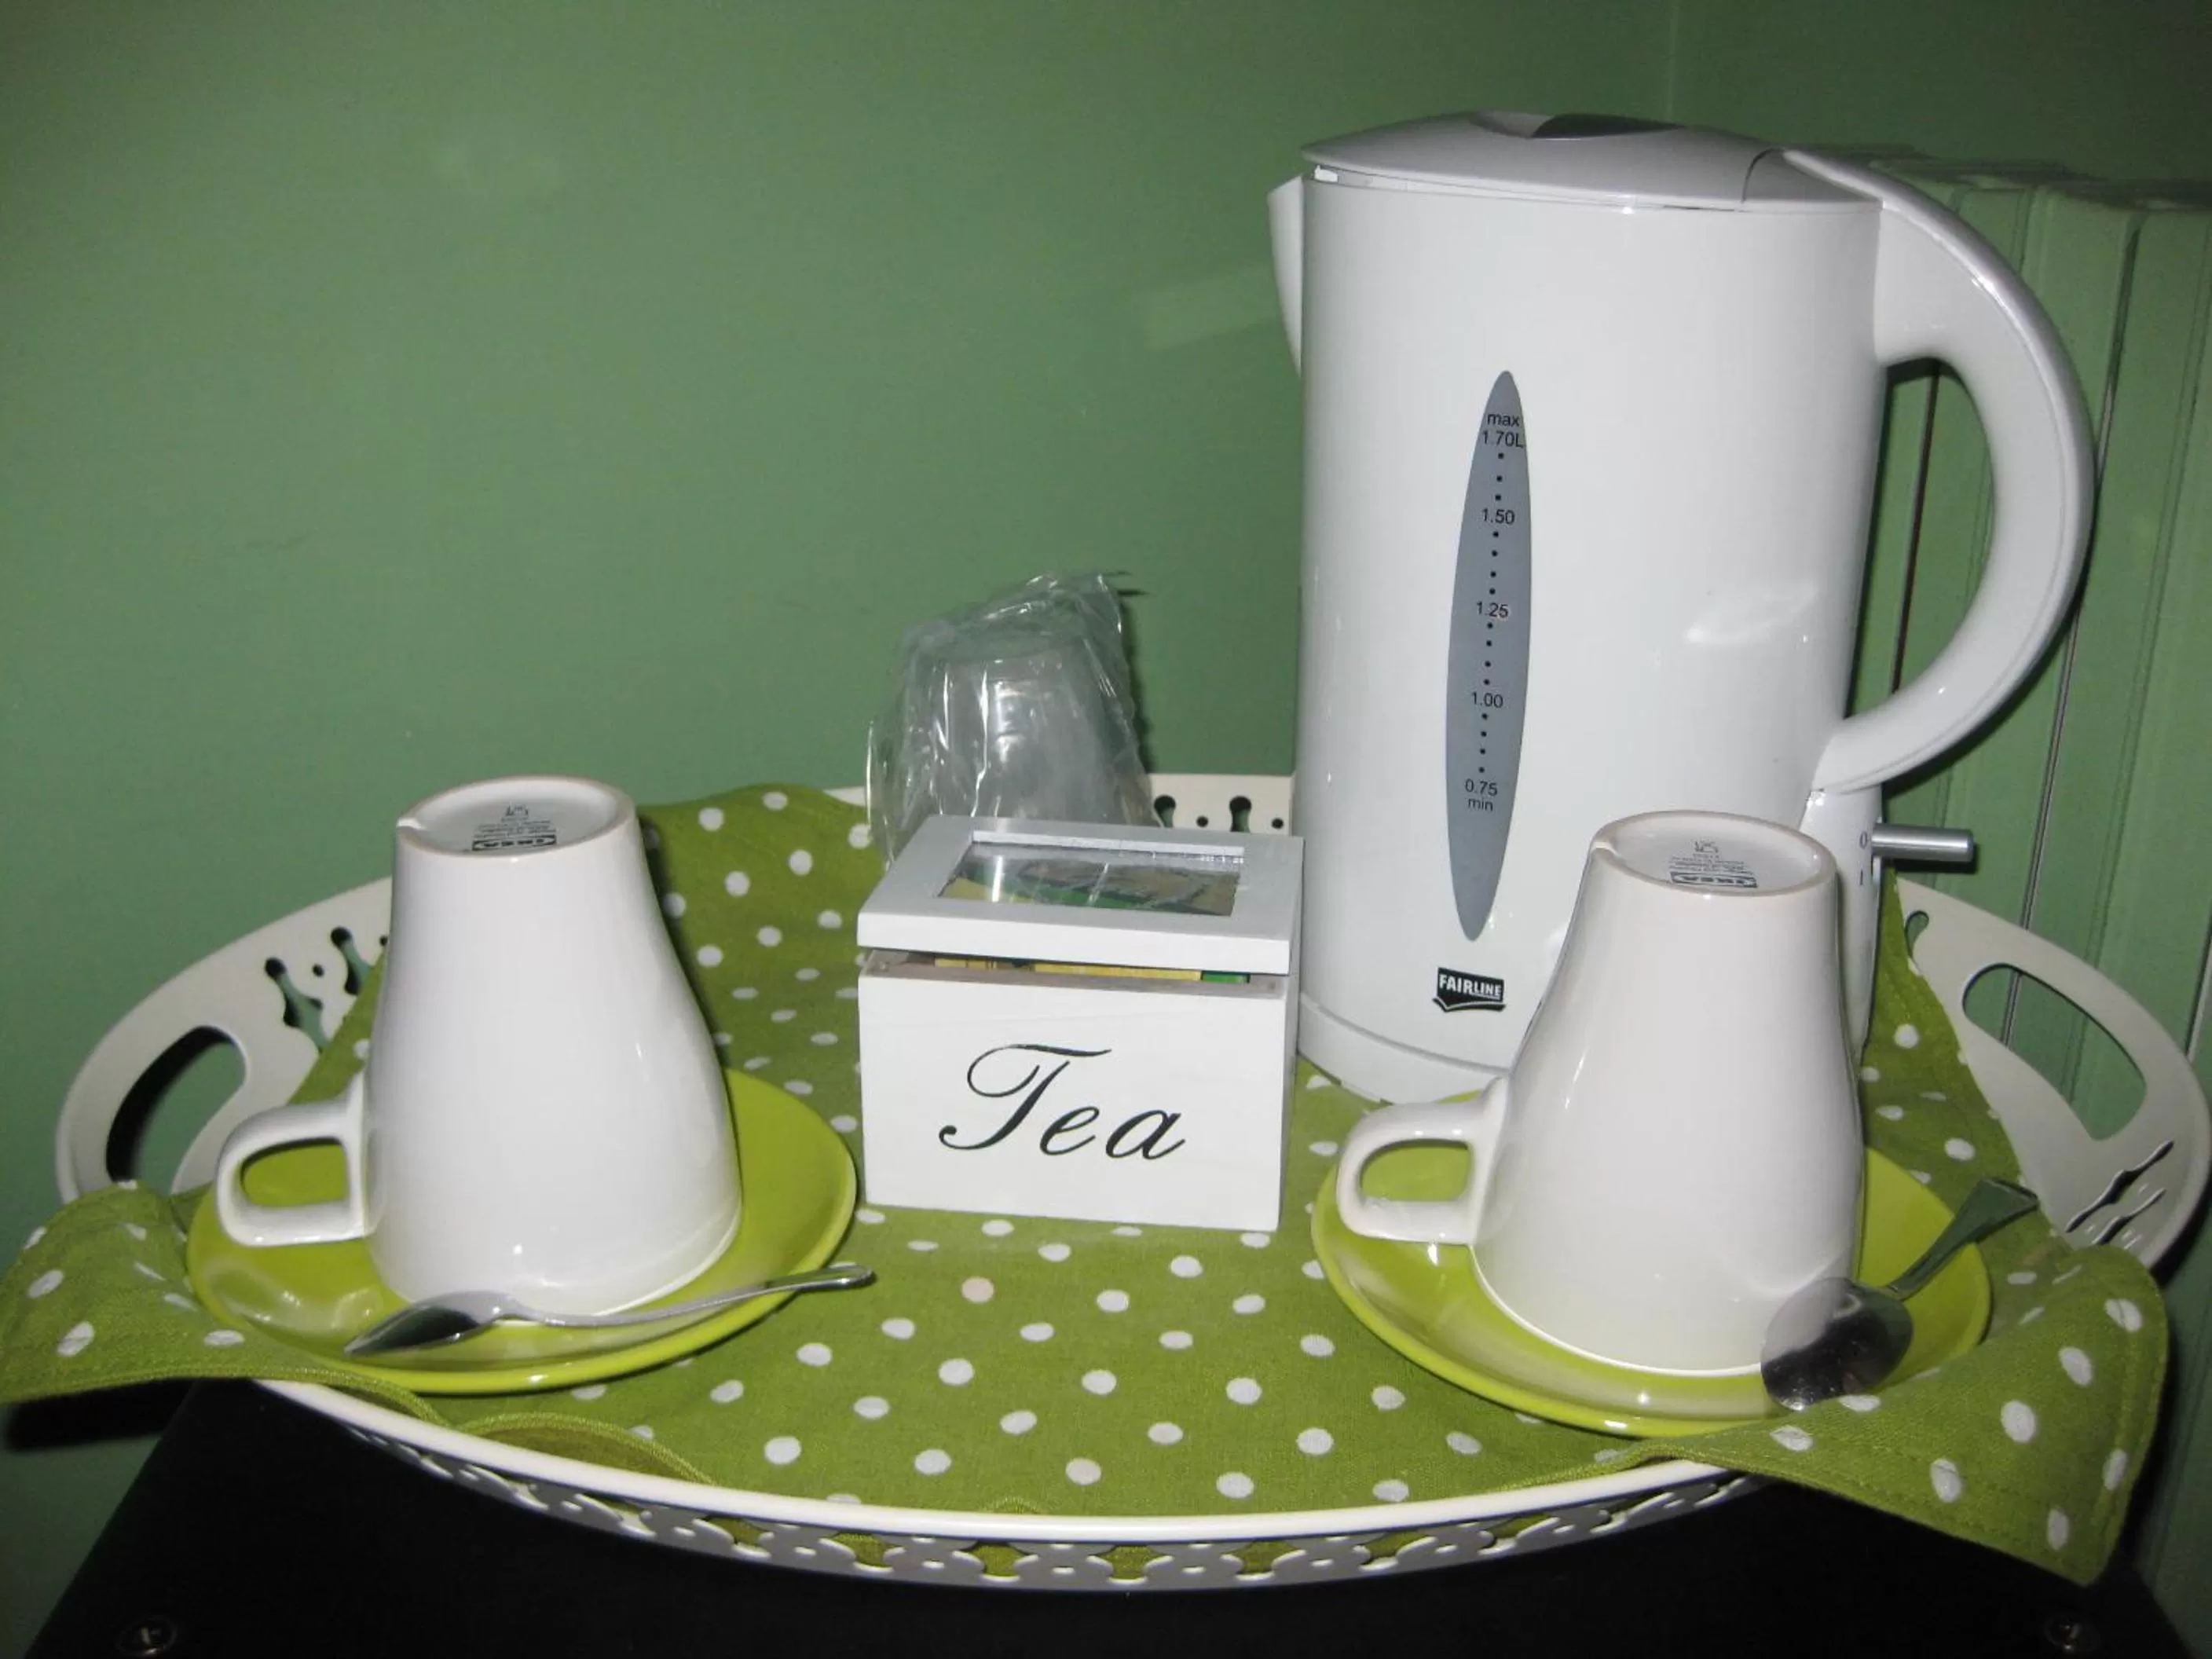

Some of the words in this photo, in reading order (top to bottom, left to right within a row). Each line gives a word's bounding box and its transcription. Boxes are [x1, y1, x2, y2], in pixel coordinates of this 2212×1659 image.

[1487, 413, 1520, 427] max
[1481, 430, 1525, 449] 1.70L
[1481, 508, 1515, 526] 1.50
[1476, 601, 1509, 618] 1.25
[1470, 691, 1504, 709] 1.00
[1464, 778, 1499, 797] 0.75
[1467, 797, 1494, 812] min
[1438, 973, 1503, 998] FAIRLINE
[939, 1042, 1186, 1161] Tea
